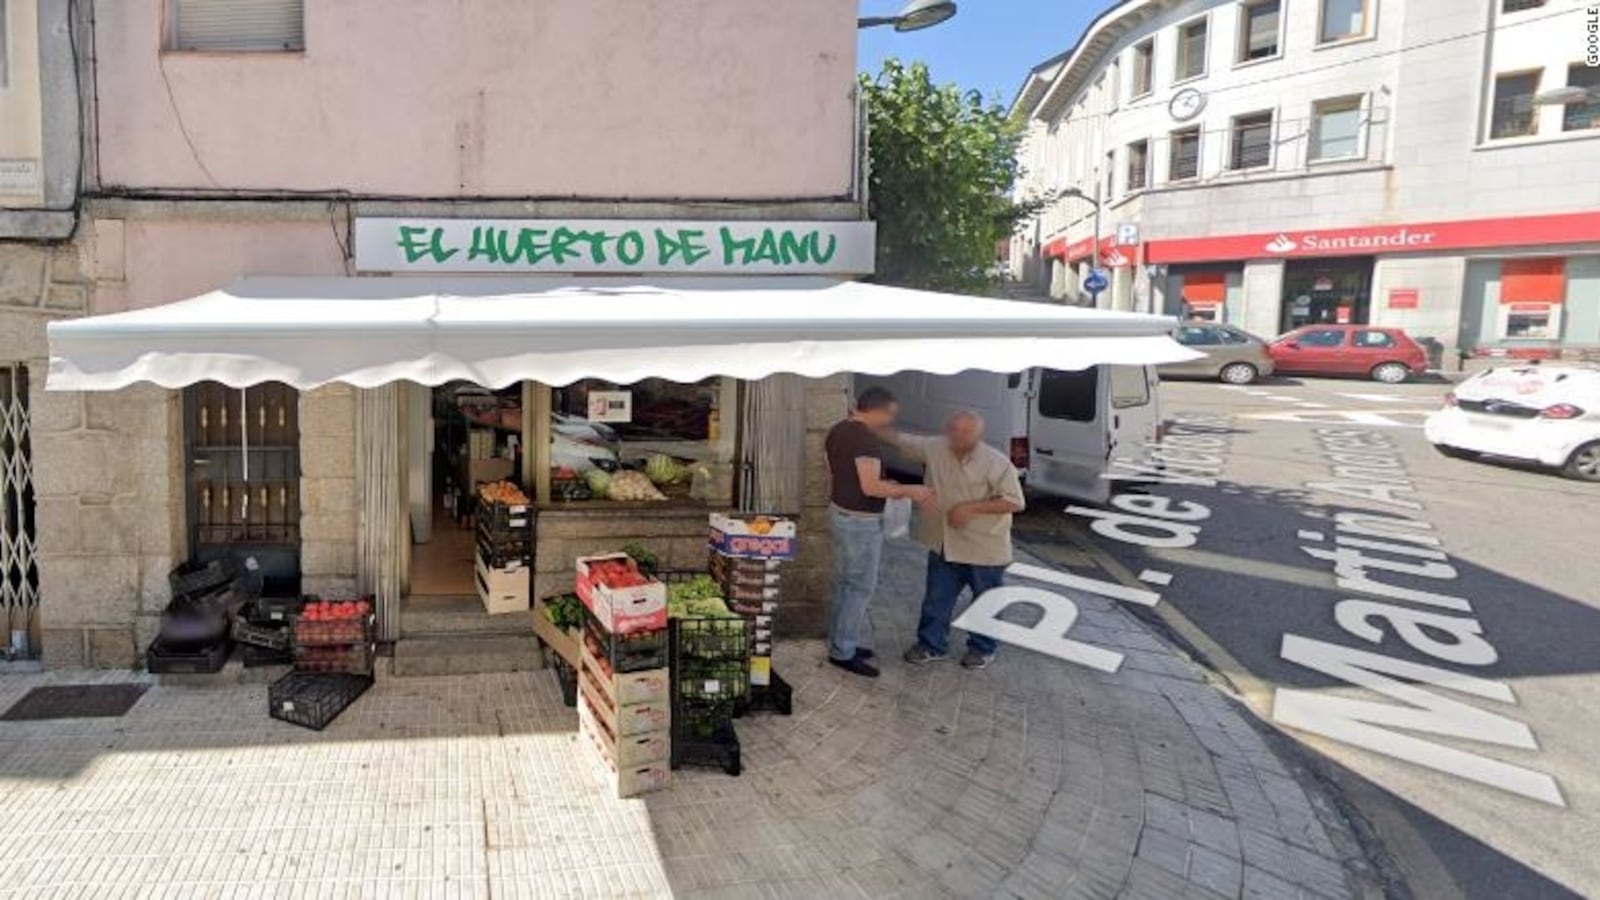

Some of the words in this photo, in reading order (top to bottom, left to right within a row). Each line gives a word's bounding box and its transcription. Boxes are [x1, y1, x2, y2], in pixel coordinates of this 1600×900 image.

[397, 226, 459, 265] EL
[468, 225, 647, 266] HUERTO
[656, 227, 711, 266] DE
[721, 226, 837, 266] MANU
[1302, 229, 1436, 250] Santander
